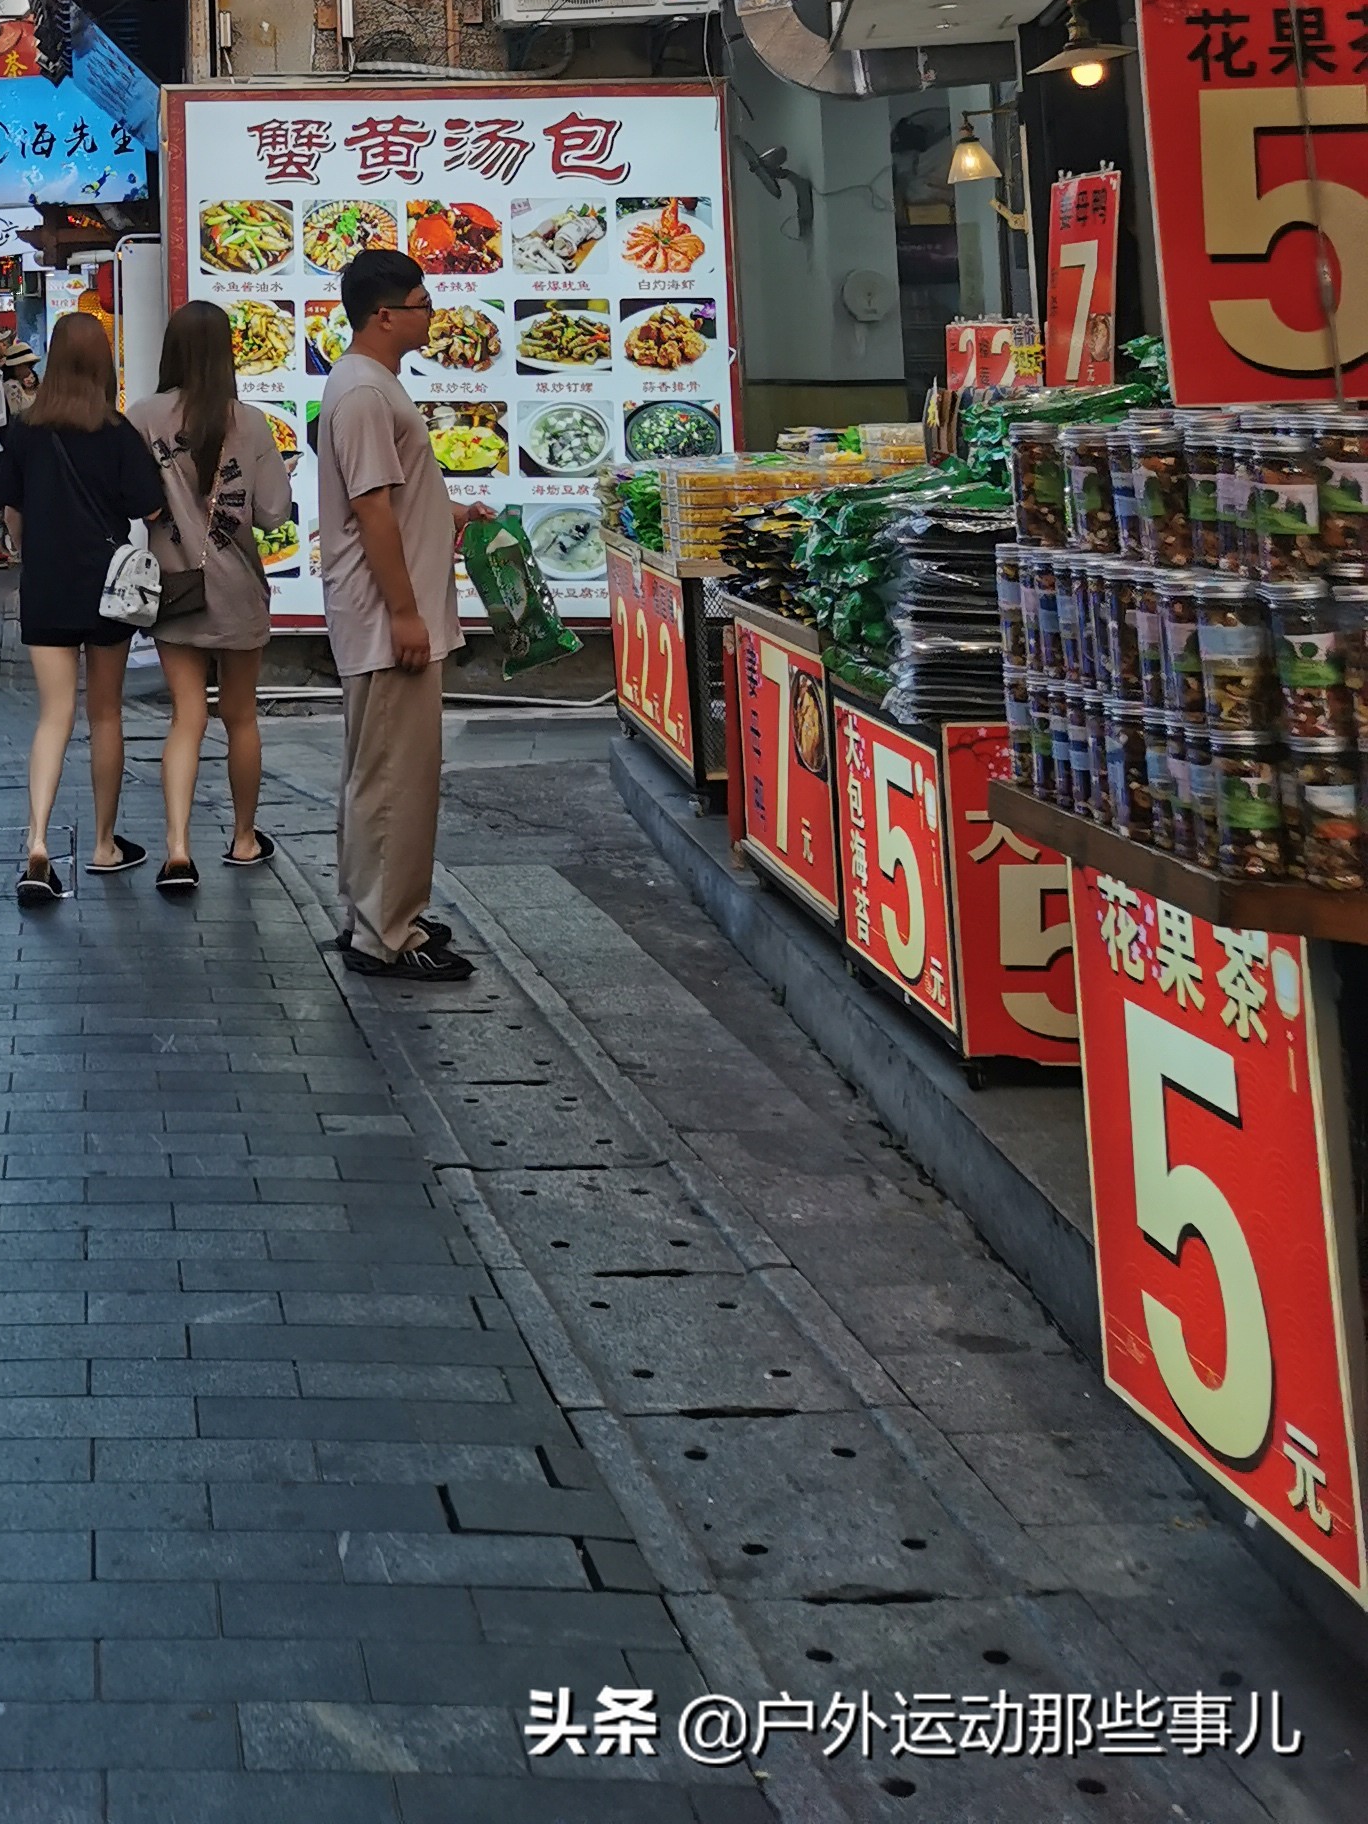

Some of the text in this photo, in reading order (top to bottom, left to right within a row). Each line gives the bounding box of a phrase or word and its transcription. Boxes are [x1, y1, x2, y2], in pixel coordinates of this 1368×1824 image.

[3, 52, 28, 77] 茶
[246, 111, 631, 186] 蟹黄汤包
[435, 280, 479, 293] 香辣蟹
[638, 279, 696, 292] 白灼海虾
[1198, 83, 1368, 378] 5
[1060, 240, 1099, 383] 7
[535, 381, 594, 394] 爆炒钉螺
[642, 381, 702, 394] 蒜香排骨
[760, 639, 789, 856] 7
[843, 714, 871, 947] 大包海苔
[872, 741, 947, 1009] 5 元
[1096, 873, 1272, 1045] 花果茶
[1123, 999, 1334, 1536] 5 元
